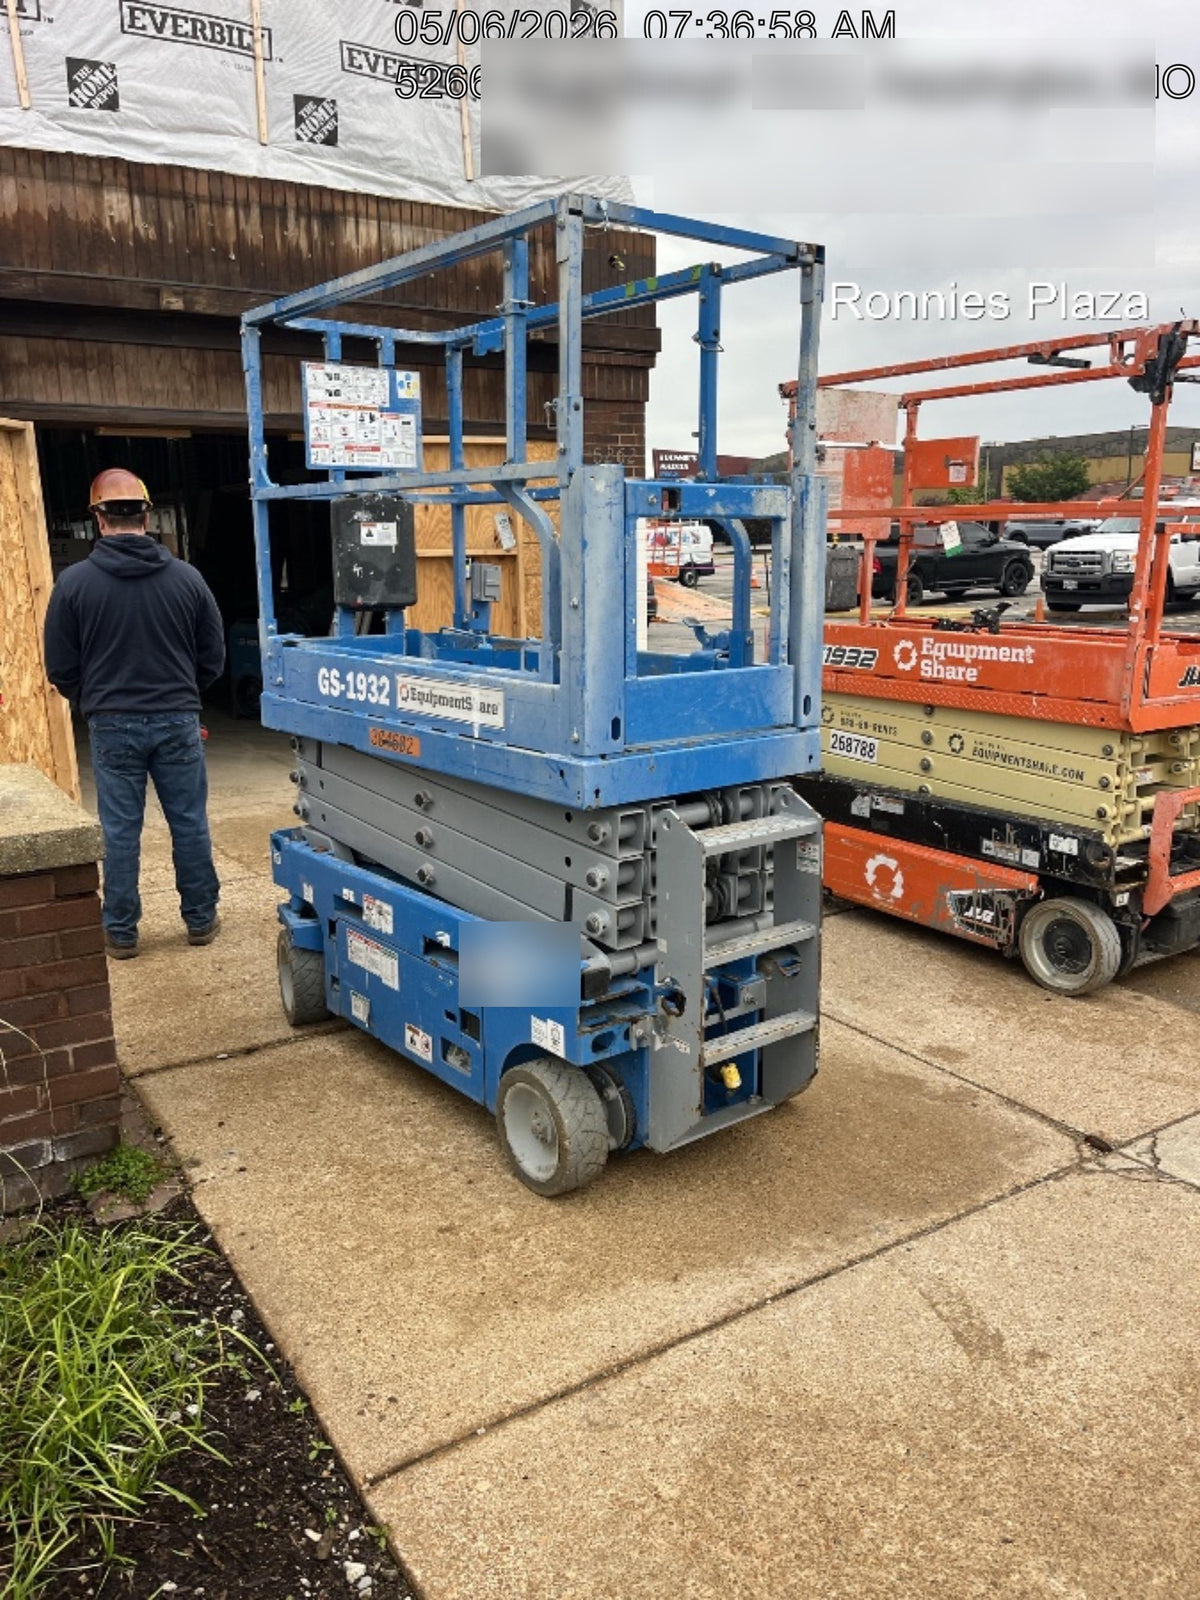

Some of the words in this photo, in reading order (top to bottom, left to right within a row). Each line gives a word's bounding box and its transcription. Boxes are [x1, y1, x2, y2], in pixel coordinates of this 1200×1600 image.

[127, 5, 265, 51] EVERBIL
[69, 62, 118, 108] HOME
[72, 65, 93, 82] THE
[90, 82, 119, 110] DEPOT
[295, 99, 337, 142] HOME
[920, 637, 1035, 664] Equipment
[920, 658, 978, 681] Share
[1178, 666, 1200, 687] JL
[318, 667, 390, 706] GS-1932
[410, 687, 500, 716] EquipmentSare
[831, 733, 876, 759] 268788
